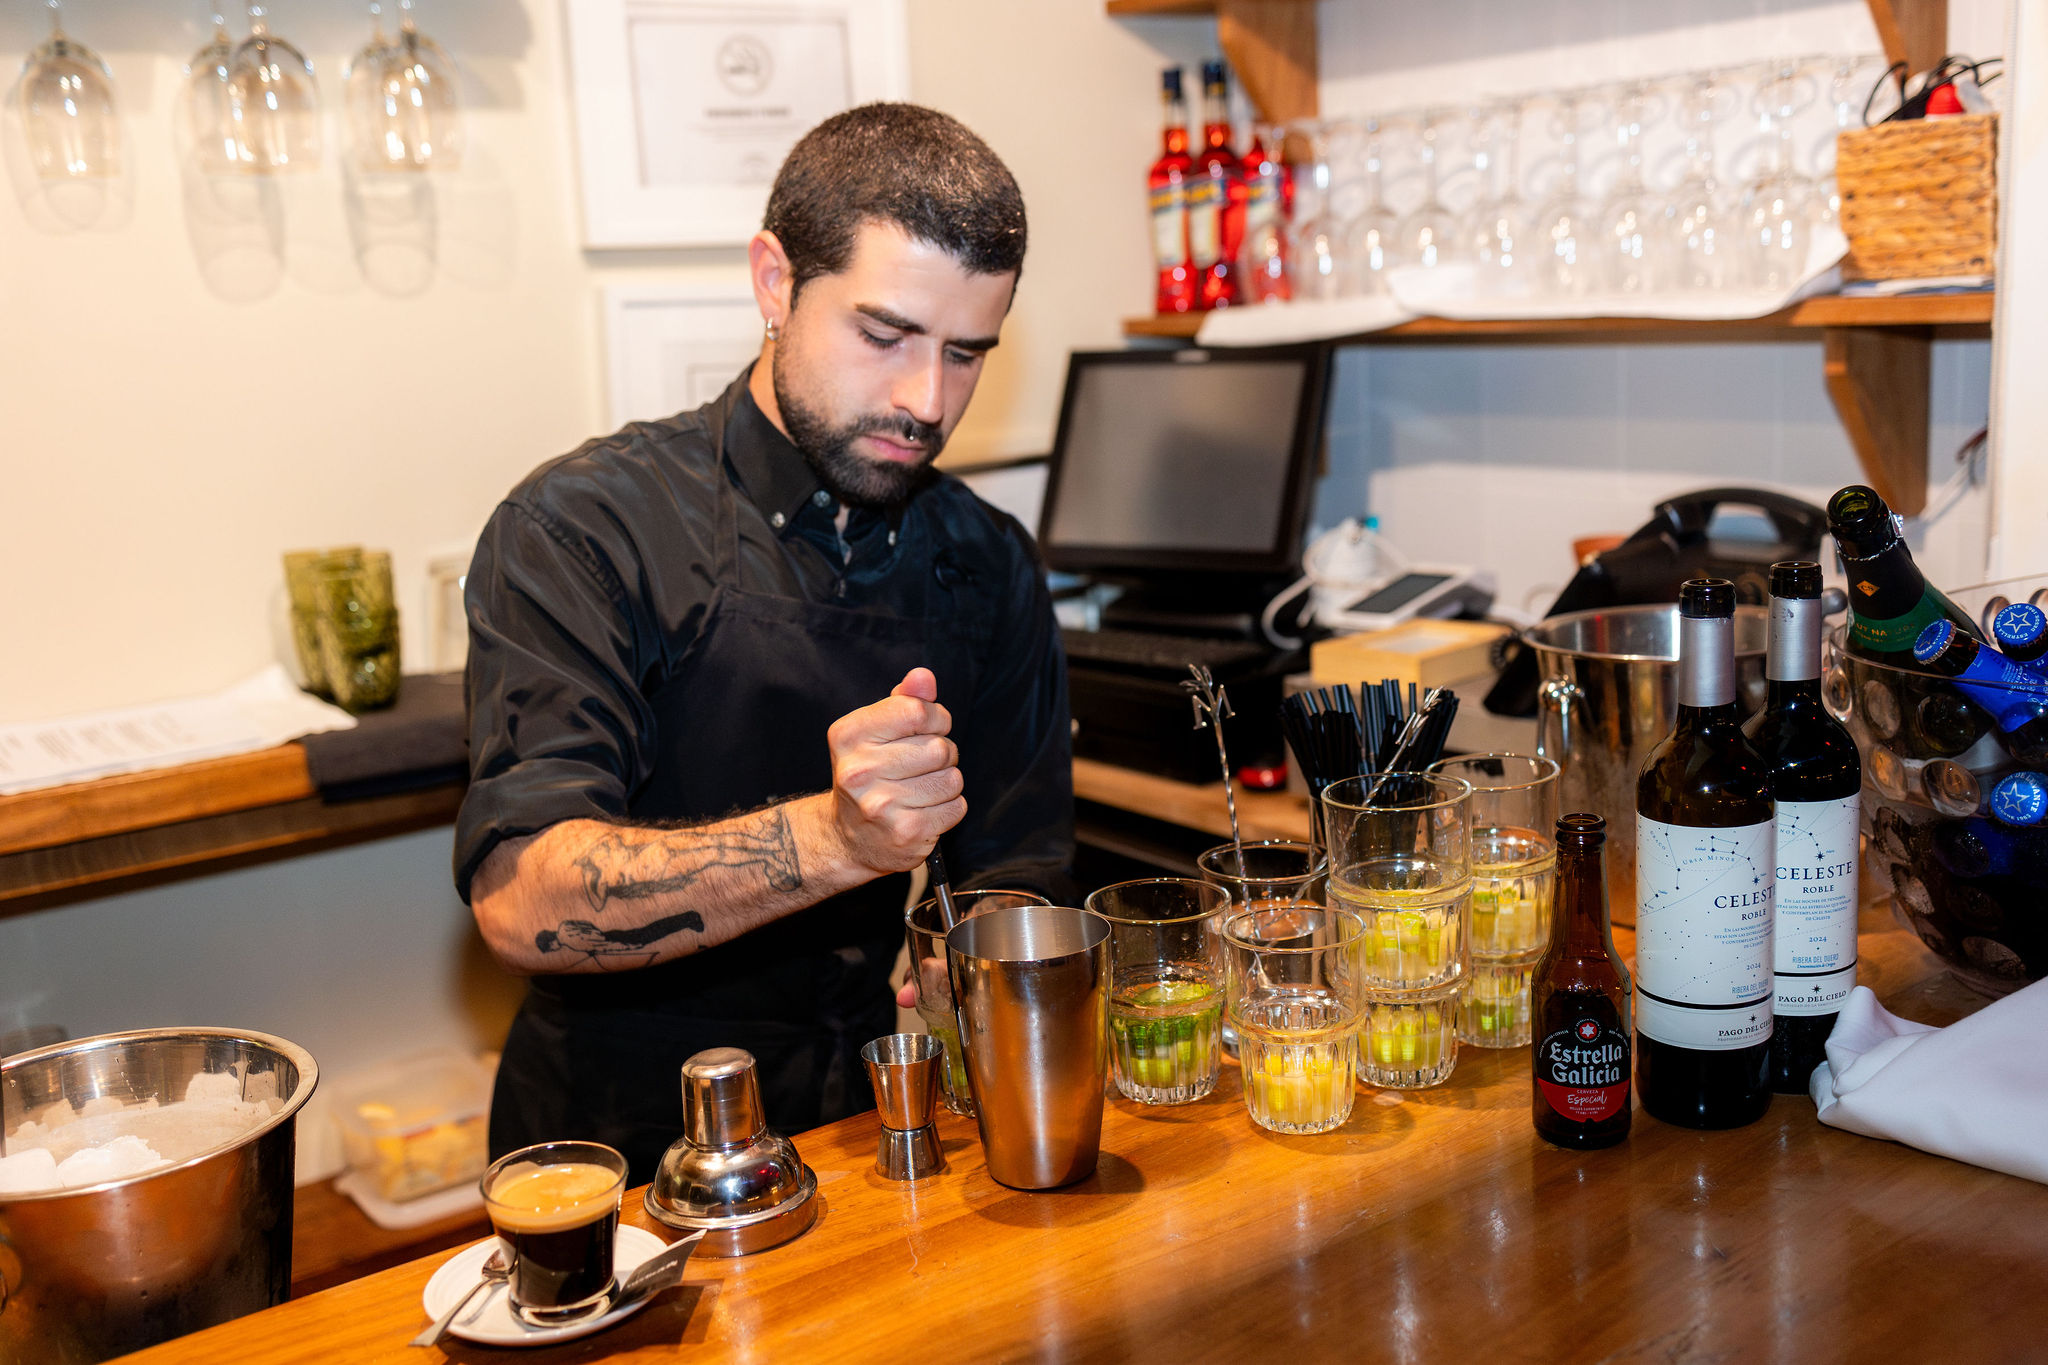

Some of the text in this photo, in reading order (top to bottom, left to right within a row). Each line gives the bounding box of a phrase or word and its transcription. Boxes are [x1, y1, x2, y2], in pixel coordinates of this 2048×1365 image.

[1996, 604, 2021, 620] LEVANTE
[1999, 628, 2028, 639] ESTRELLA
[1775, 861, 1853, 880] CELESTE
[1802, 885, 1835, 894] ROBLE
[1741, 908, 1767, 921] ROBLE
[1746, 962, 1761, 970] 2024
[1792, 956, 1812, 964] RIBERA
[1778, 990, 1847, 1003] PAGO DEL CIELO
[1718, 1028, 1743, 1037] PAGO
[1745, 1025, 1759, 1034] DEL
[1549, 1041, 1623, 1065] Estrella
[1551, 1062, 1620, 1086] Galicia
[1567, 1090, 1608, 1106] Especial
